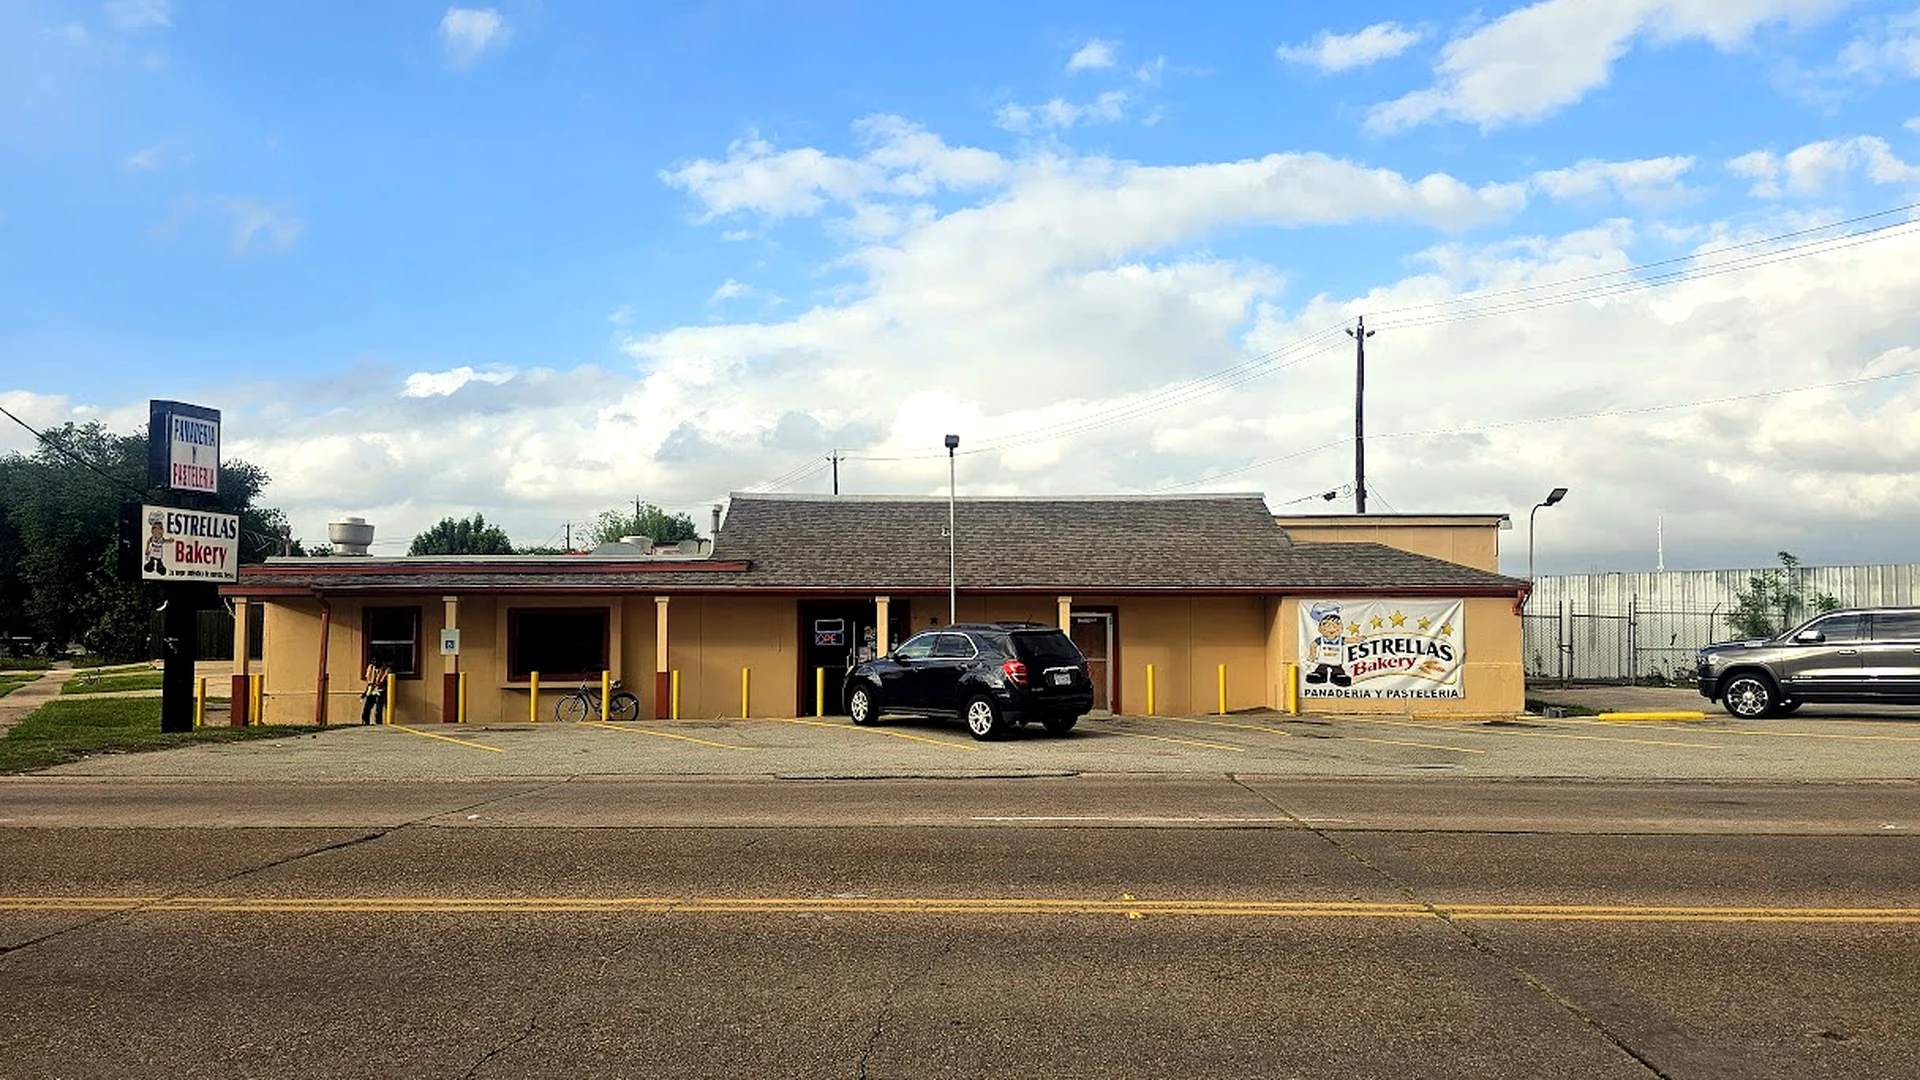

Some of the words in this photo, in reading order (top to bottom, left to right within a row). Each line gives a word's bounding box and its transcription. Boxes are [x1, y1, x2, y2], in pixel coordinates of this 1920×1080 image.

[173, 463, 214, 489] PASTELERIA
[166, 512, 236, 540] ESTRELLAS
[175, 540, 228, 569] Bakery
[1347, 638, 1453, 662] ESTRELLAS
[1352, 657, 1417, 677] Bakery
[1304, 689, 1371, 698] PANADERIA
[1375, 690, 1382, 698] Y
[1386, 690, 1459, 699] PASTELERIA
